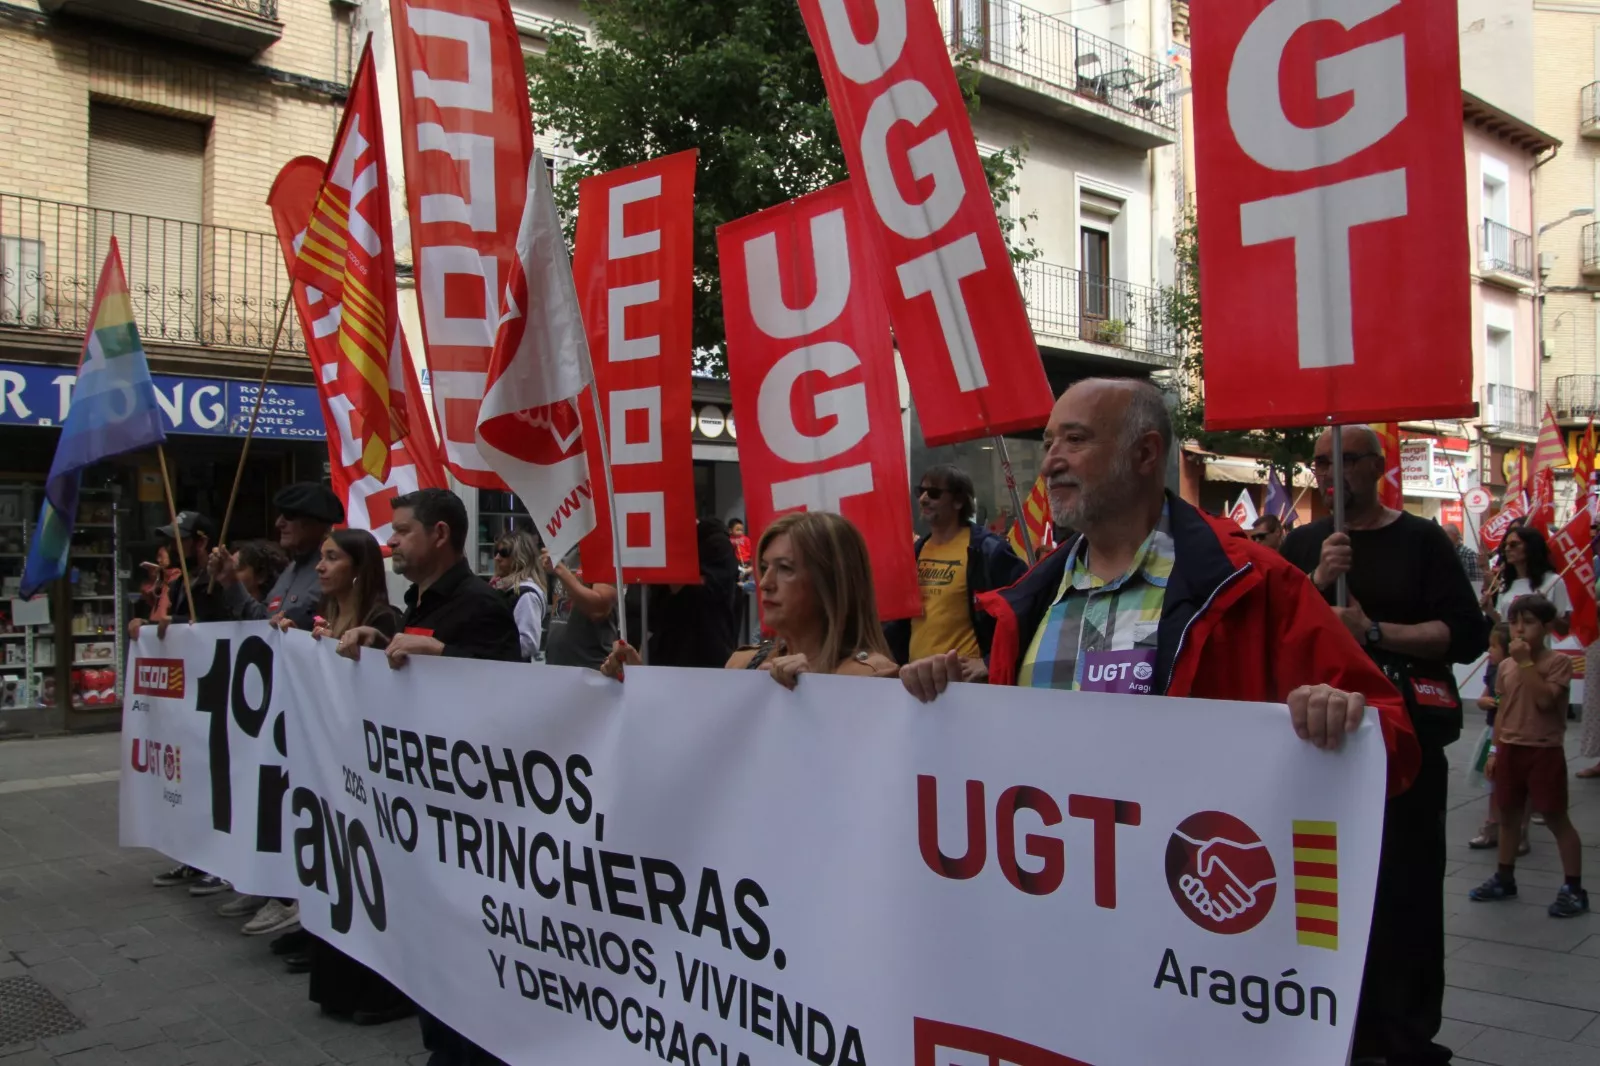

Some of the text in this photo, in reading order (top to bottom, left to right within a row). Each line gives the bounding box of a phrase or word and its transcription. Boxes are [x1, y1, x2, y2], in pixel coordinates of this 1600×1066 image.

[608, 175, 667, 568] CCOO
[240, 396, 296, 407] BOLSOS
[281, 428, 328, 437] ESCOL
[1088, 662, 1132, 682] UGT
[1129, 682, 1151, 693] Arag
[342, 765, 368, 805] 2026
[363, 719, 605, 842] DERECHOS,
[917, 773, 1141, 910] UGT
[372, 787, 787, 971] NO TRINCHERAS.
[481, 895, 867, 1066] SALARIOS, VIVIENDA
[488, 949, 506, 989] Y
[1153, 948, 1337, 1026] Aragón
